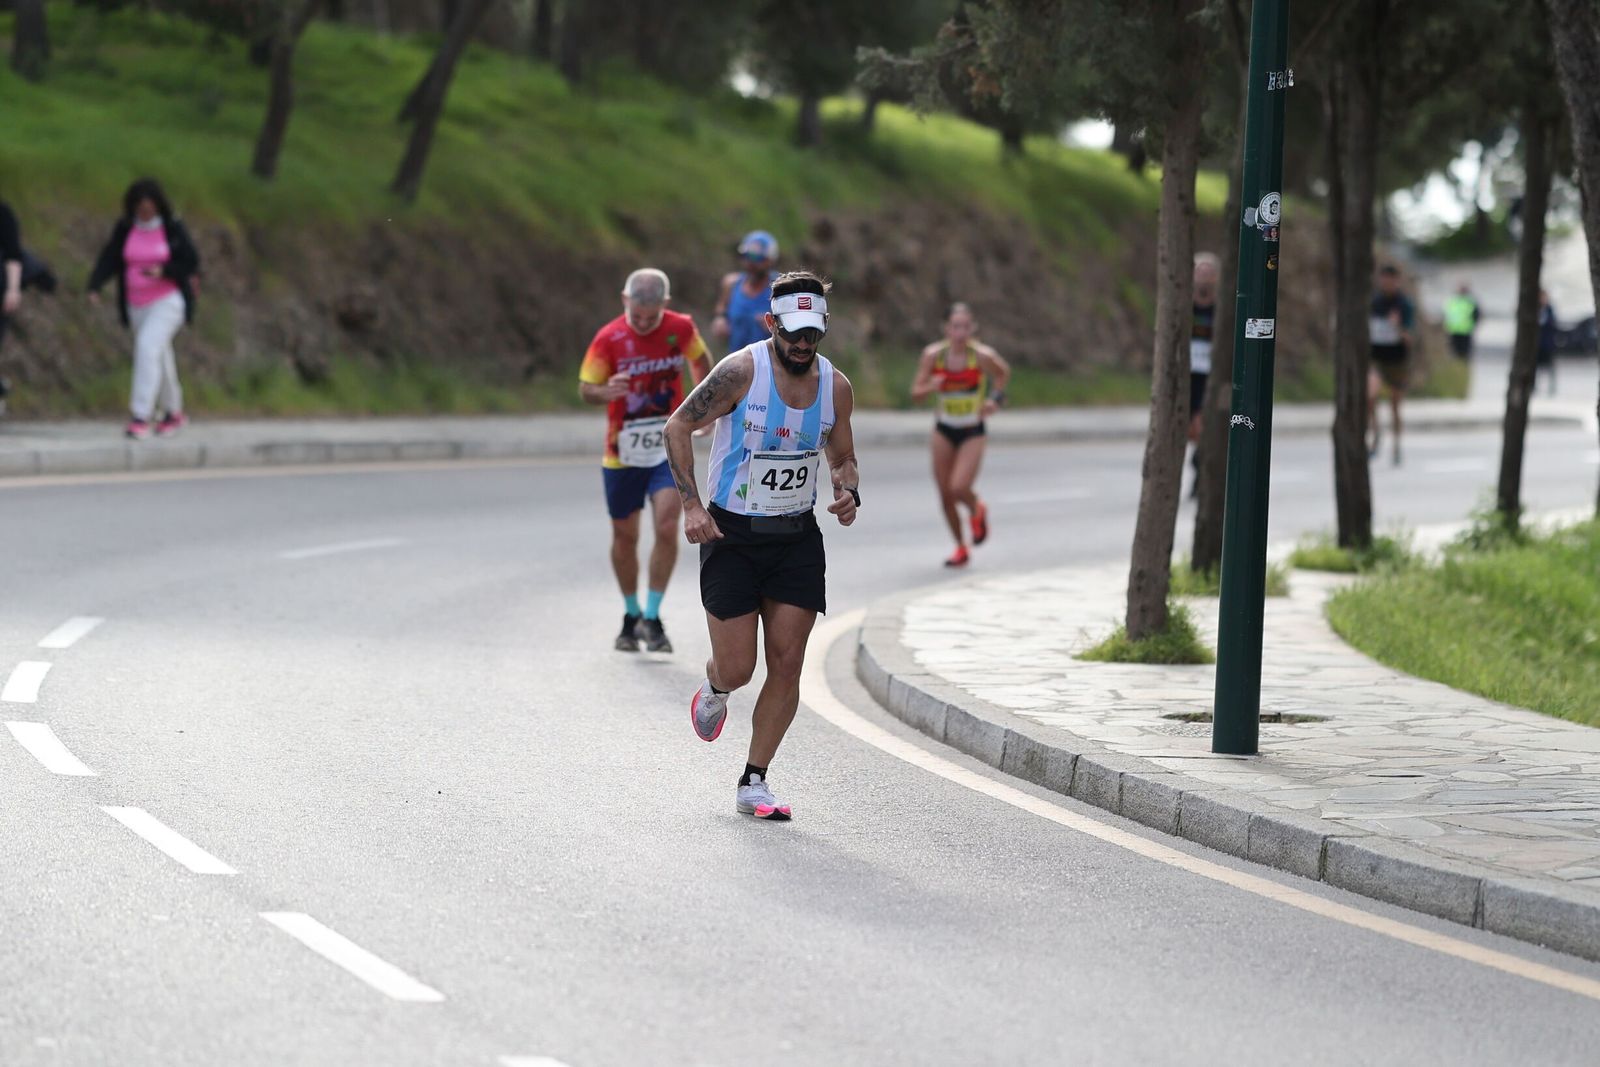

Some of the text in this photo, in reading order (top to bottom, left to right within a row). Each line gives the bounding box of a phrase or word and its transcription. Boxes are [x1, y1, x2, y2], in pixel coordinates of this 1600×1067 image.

[748, 403, 766, 412] vive
[629, 431, 663, 449] 762
[761, 466, 808, 491] 429
